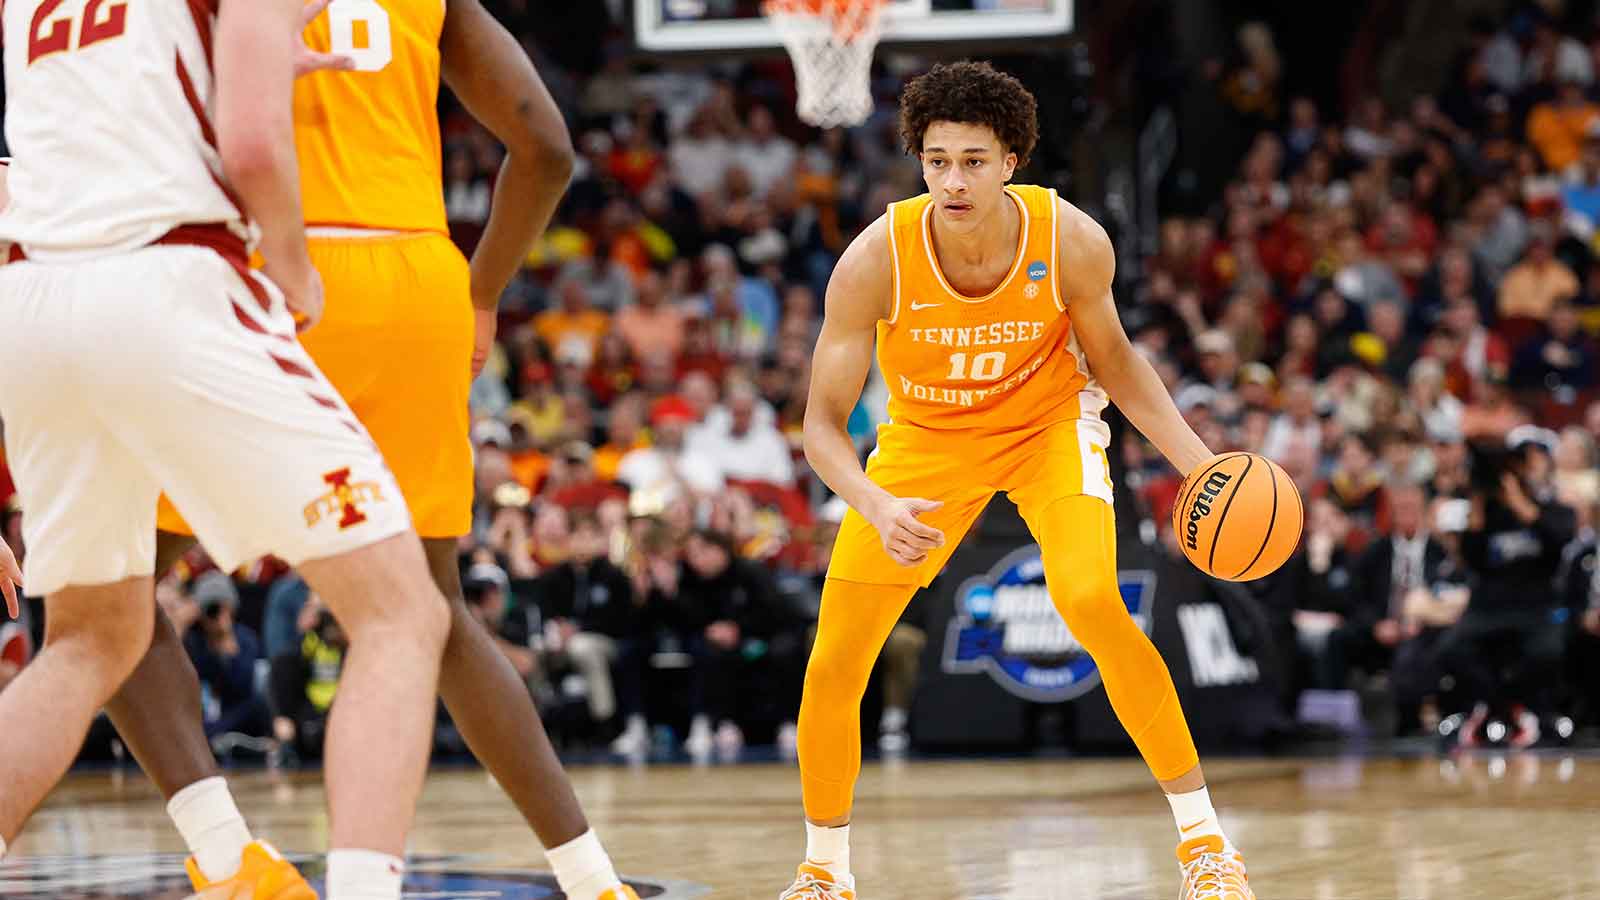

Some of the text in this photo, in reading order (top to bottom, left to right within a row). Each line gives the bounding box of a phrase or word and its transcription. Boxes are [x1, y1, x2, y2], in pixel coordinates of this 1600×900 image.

[910, 321, 1044, 346] TENNESSEE
[946, 351, 1007, 381] 10
[1187, 471, 1232, 550] Wilson
